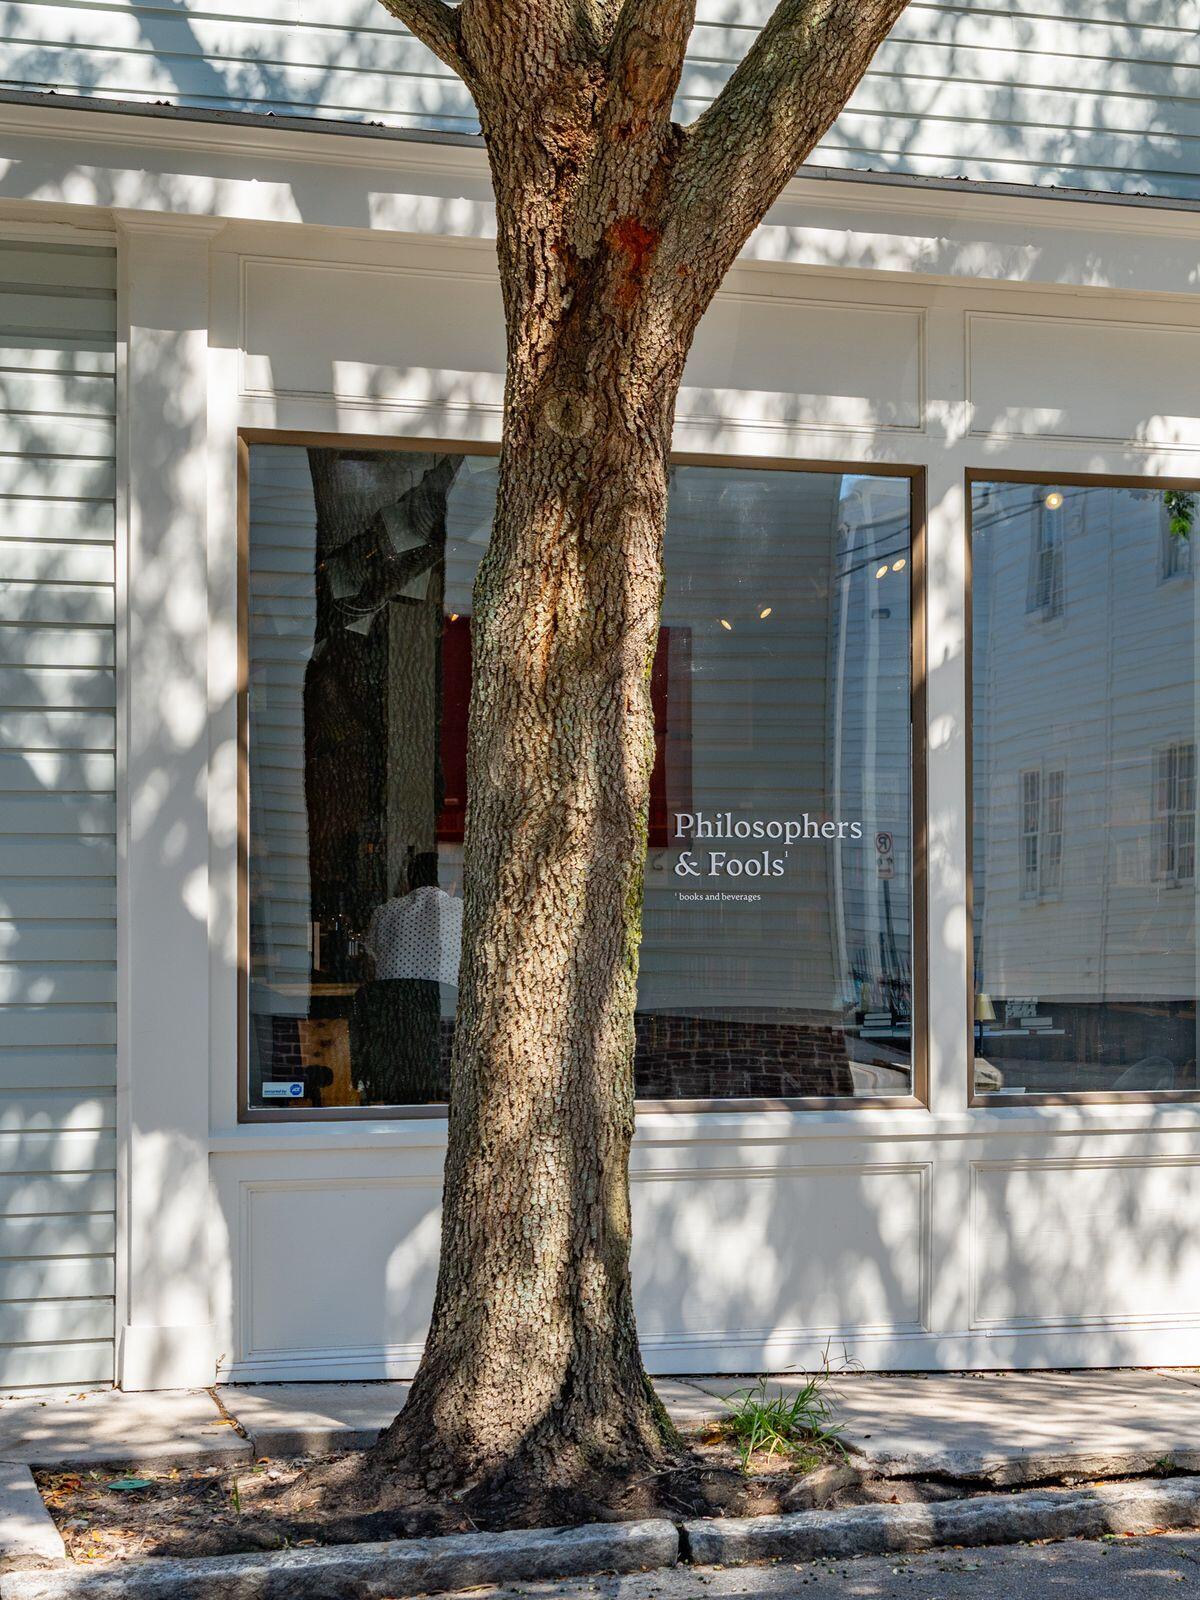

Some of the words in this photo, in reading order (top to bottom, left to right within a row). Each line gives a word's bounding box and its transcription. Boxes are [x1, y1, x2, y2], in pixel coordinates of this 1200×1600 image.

[674, 812, 863, 845] Philosophers
[674, 851, 701, 877] &
[679, 892, 704, 901] books
[704, 892, 720, 901] and
[721, 892, 761, 902] beverages
